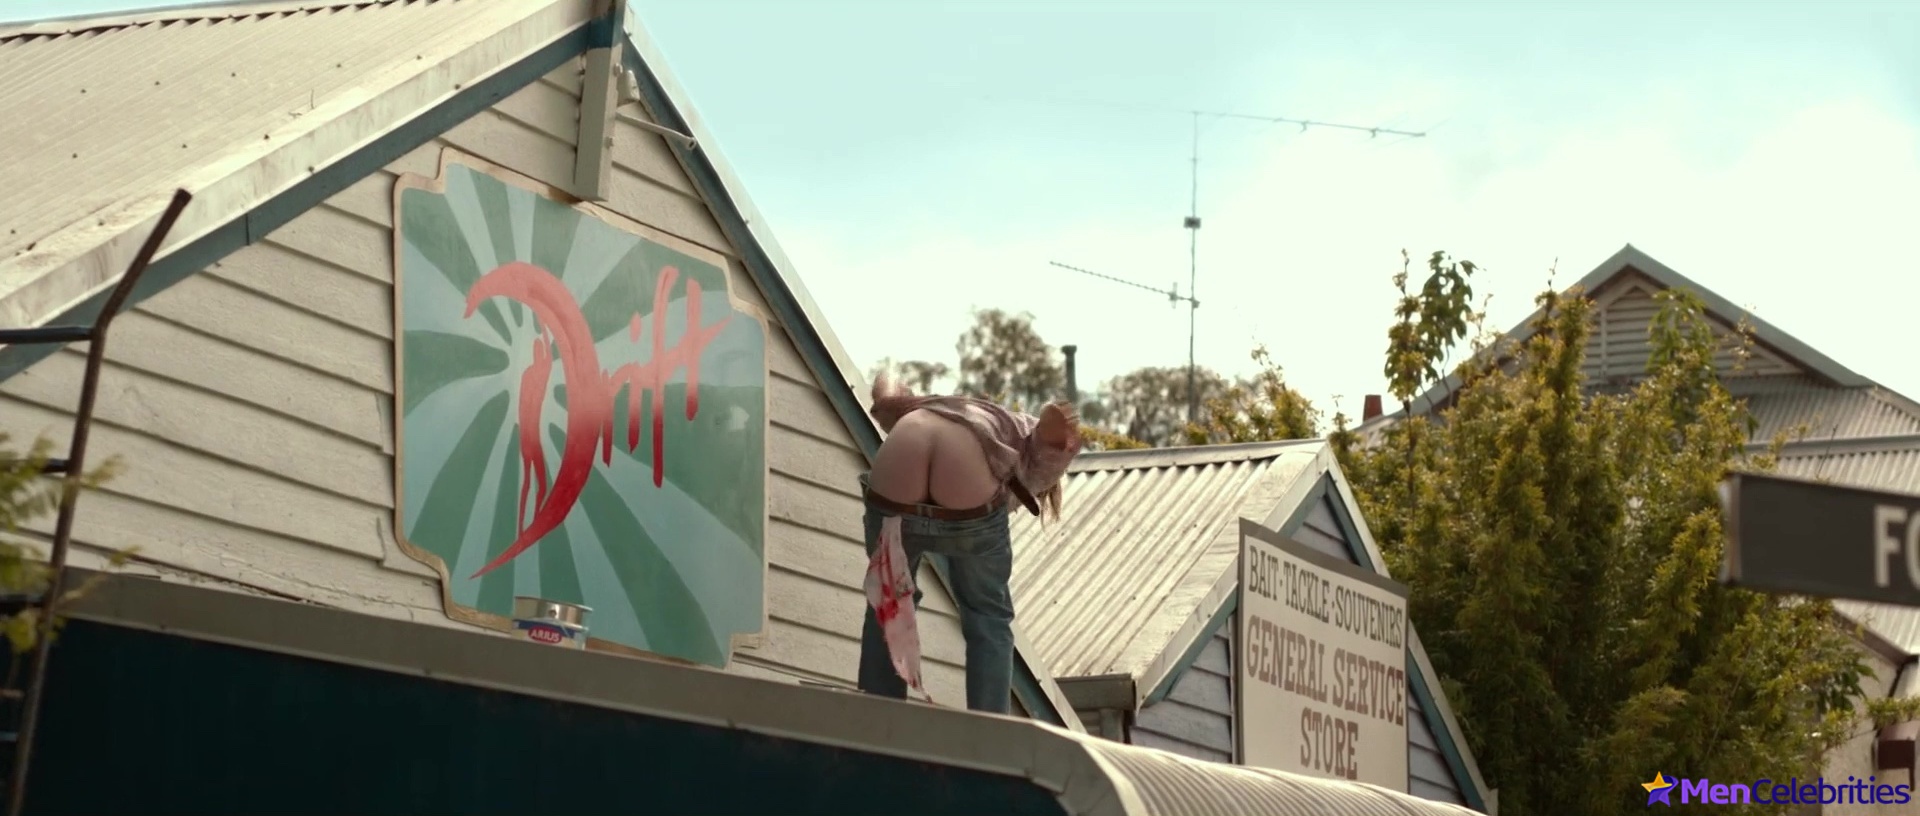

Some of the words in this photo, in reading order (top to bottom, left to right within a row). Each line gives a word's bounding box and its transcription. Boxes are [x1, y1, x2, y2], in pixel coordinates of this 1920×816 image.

[464, 261, 732, 580] Drift
[1248, 545, 1279, 601] BAIT
[1283, 561, 1330, 624] TACKLE
[1335, 585, 1403, 650] SOUVENIRS
[1247, 614, 1328, 703] GENERAL
[1333, 648, 1404, 727] SERVICE
[1300, 707, 1359, 780] STORE
